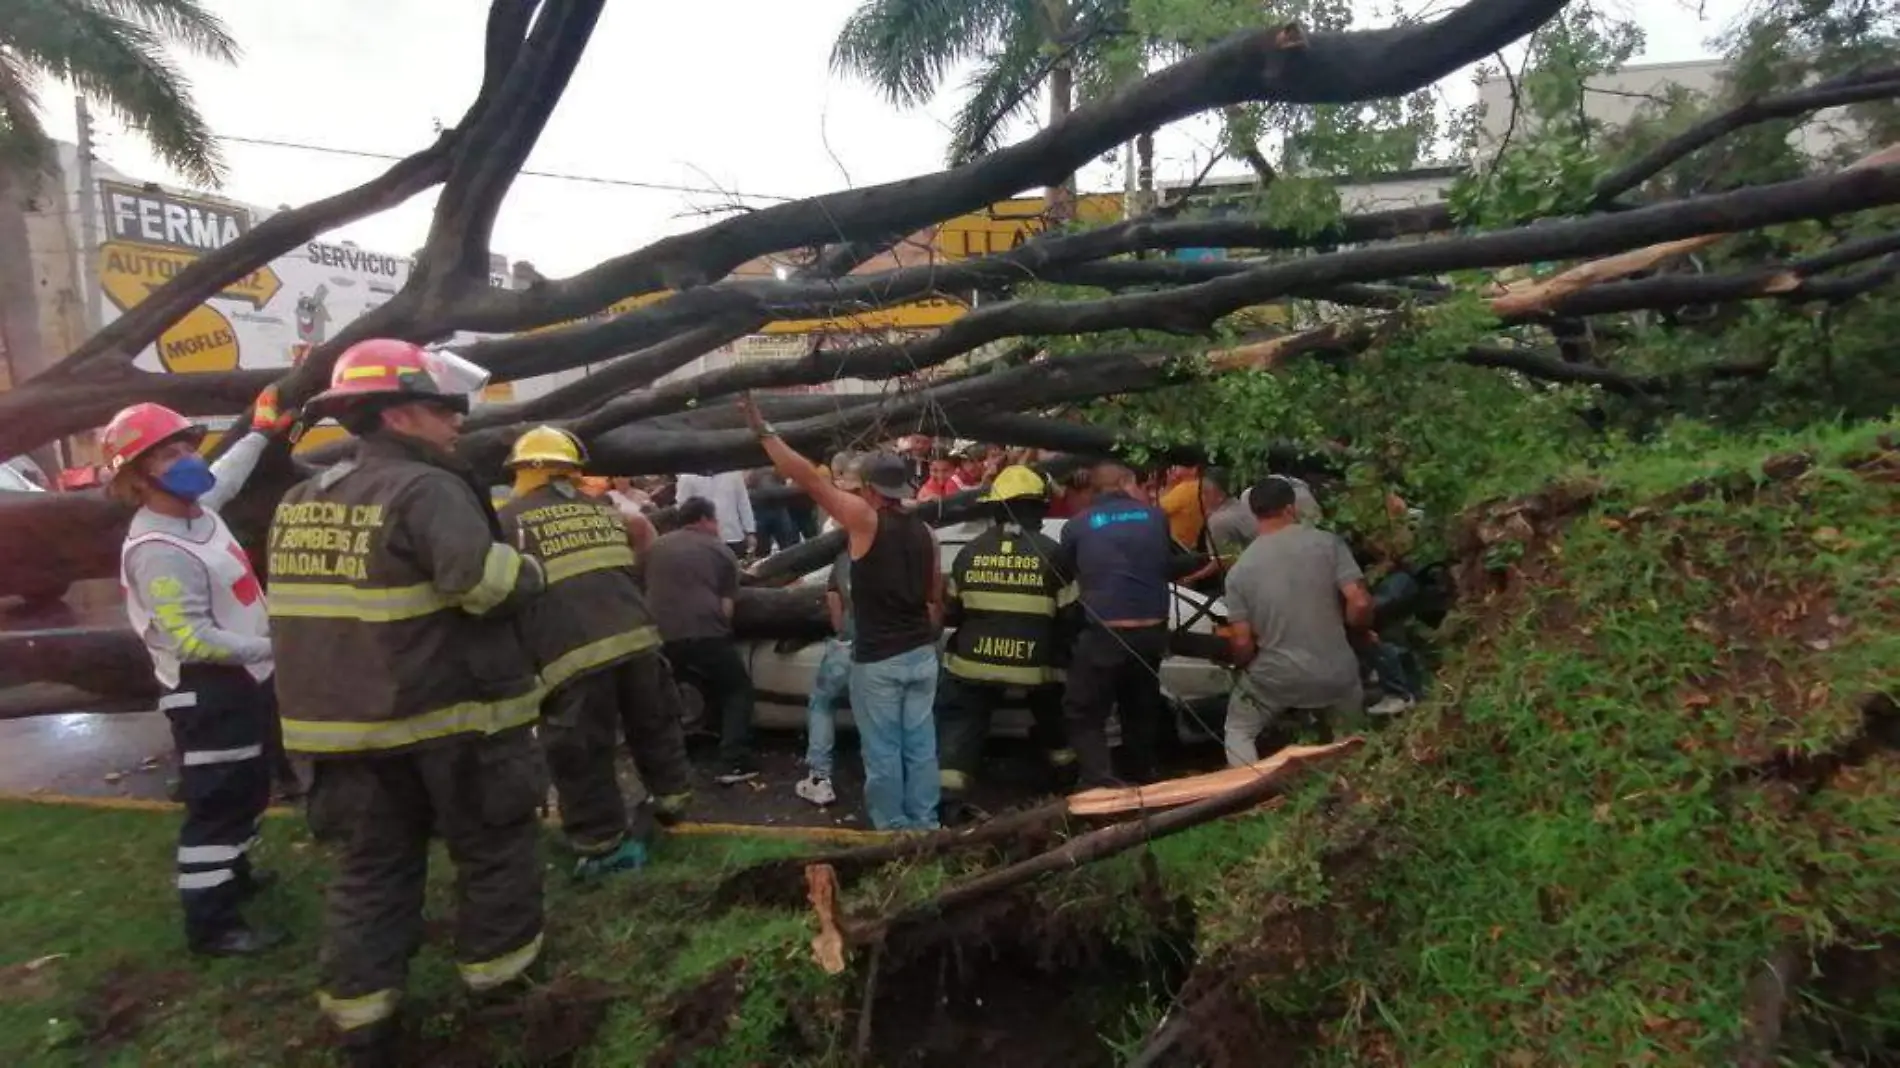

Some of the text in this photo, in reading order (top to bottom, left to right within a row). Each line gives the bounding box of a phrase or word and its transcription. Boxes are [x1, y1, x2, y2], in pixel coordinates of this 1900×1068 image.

[112, 193, 240, 249] FERMA
[308, 242, 397, 277] SERVICIO
[166, 329, 233, 359] MOFLES
[973, 554, 1040, 570] BOMBEROS
